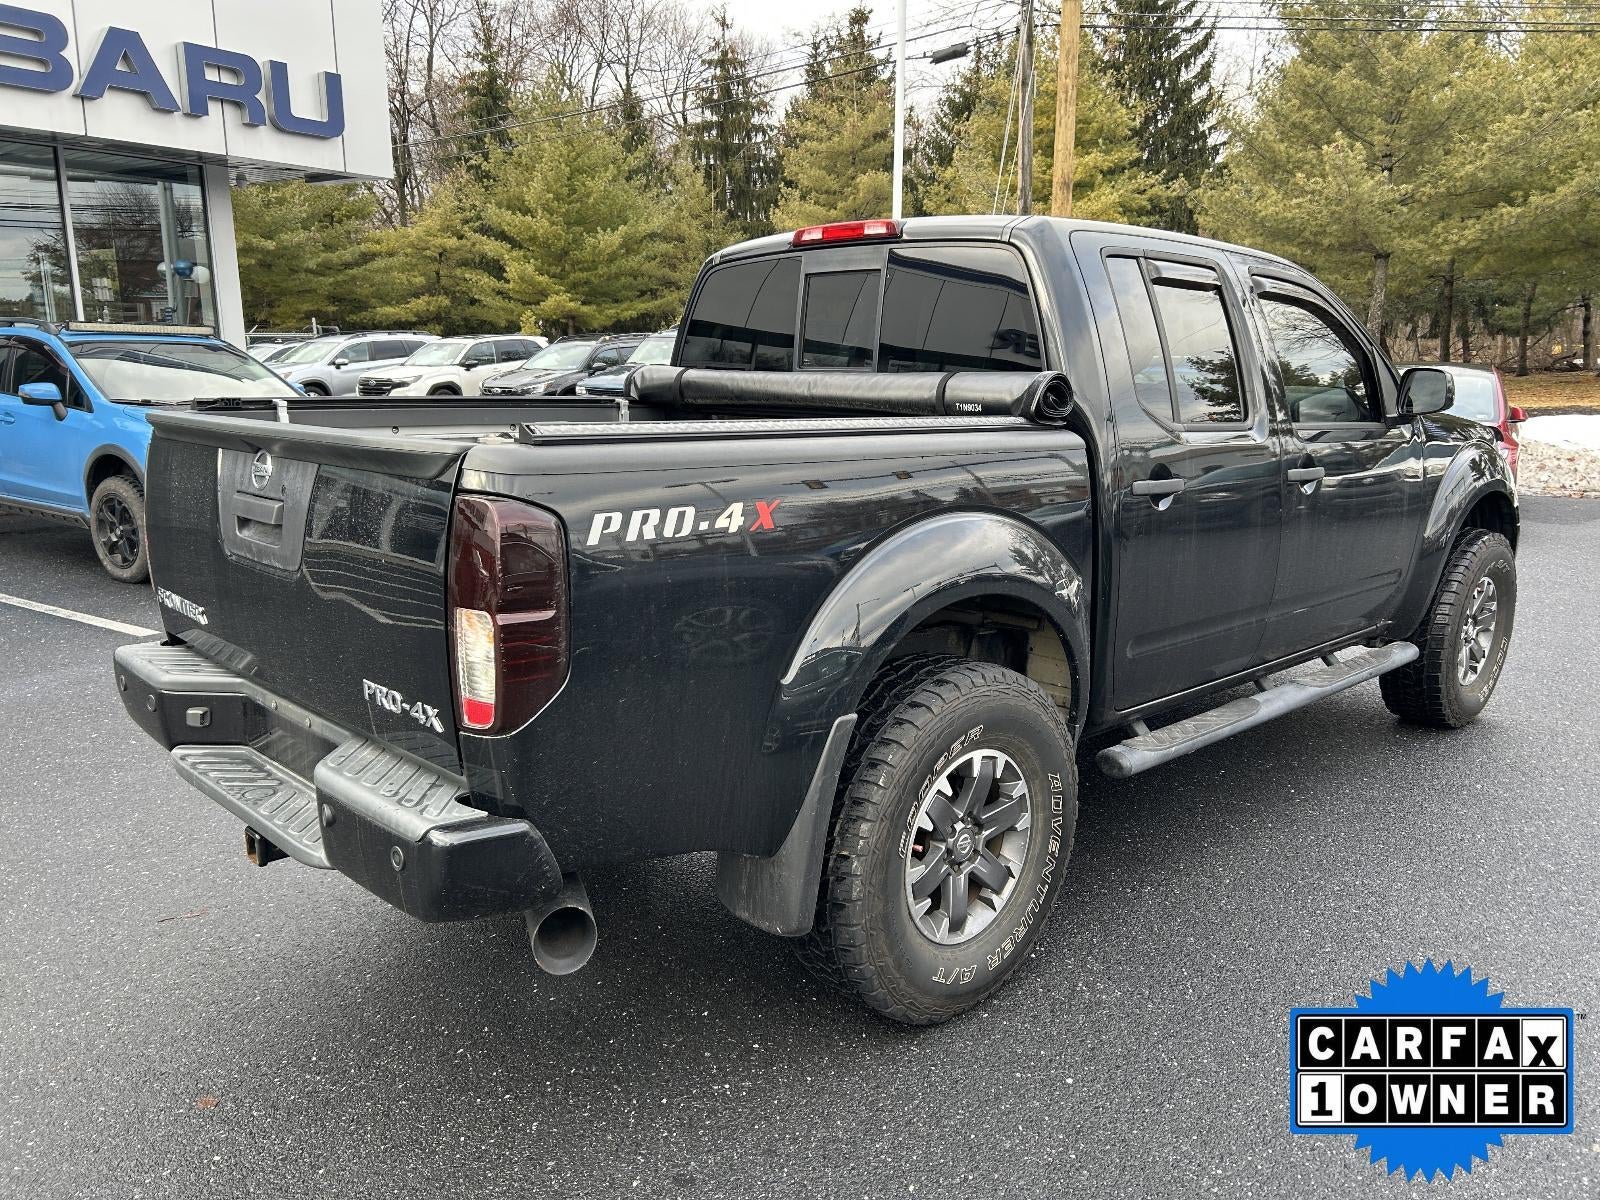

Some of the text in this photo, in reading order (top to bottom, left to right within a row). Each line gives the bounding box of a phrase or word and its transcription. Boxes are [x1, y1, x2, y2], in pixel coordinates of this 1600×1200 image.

[362, 678, 445, 733] PRO-4X
[898, 724, 984, 859] COOPER
[931, 772, 1063, 985] ADVENTURER A/T
